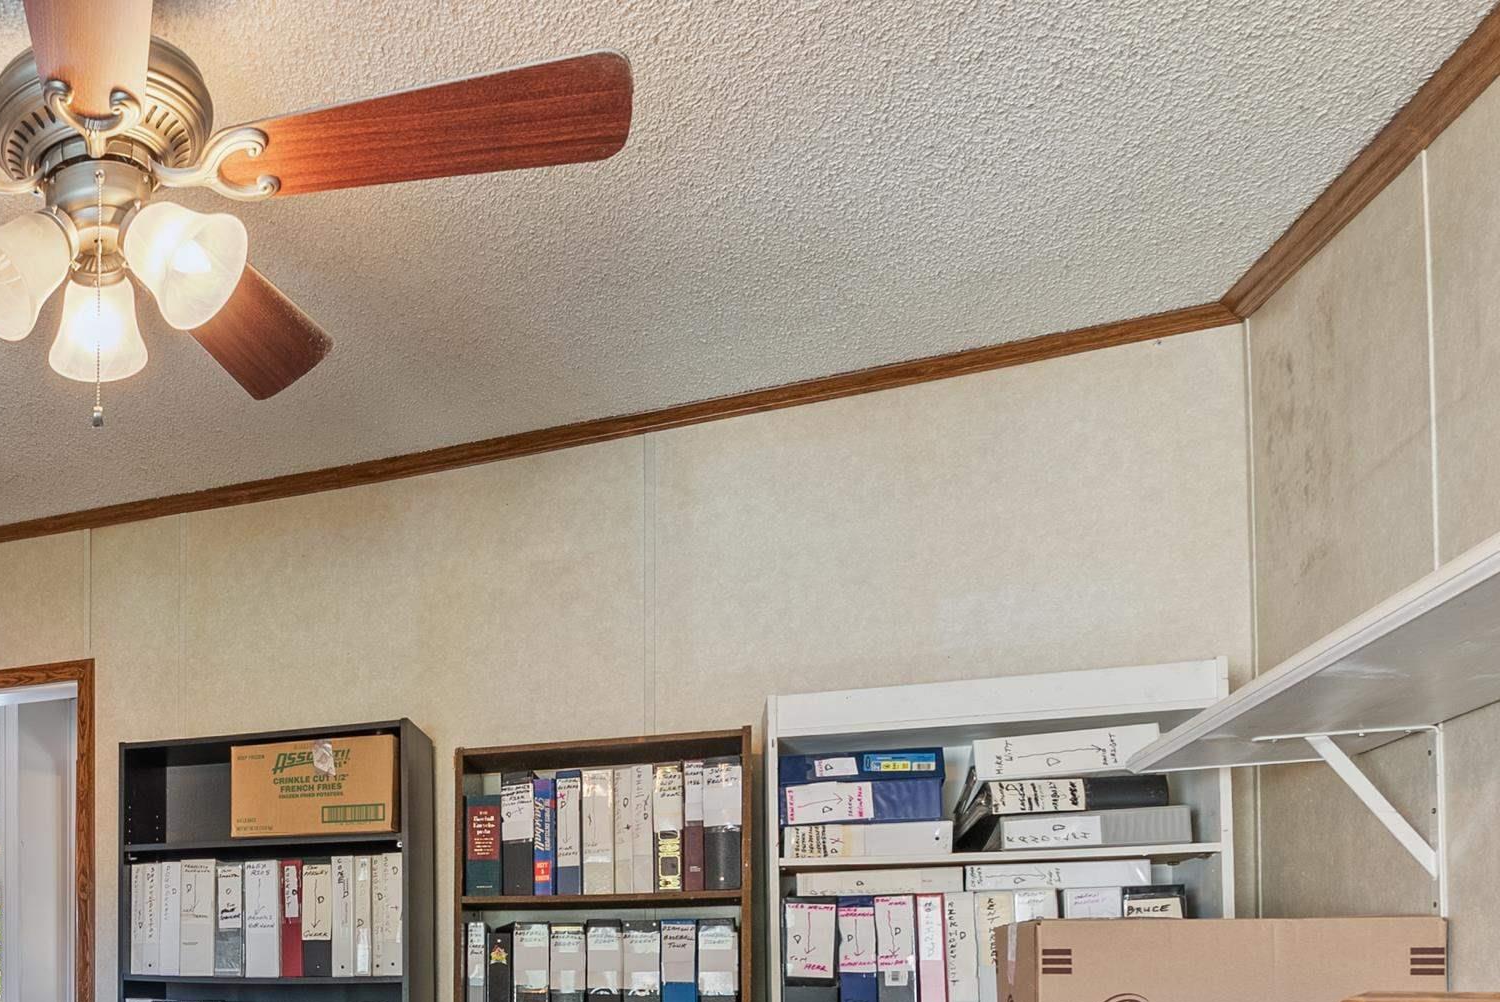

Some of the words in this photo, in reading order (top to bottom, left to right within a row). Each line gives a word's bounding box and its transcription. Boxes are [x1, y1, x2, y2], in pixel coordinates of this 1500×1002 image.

[273, 775, 311, 785] CRINKLE
[312, 774, 331, 783] CUT
[280, 785, 315, 793] FRENCH
[317, 783, 342, 791] FRIES
[534, 797, 545, 851] Baseball
[1126, 903, 1171, 916] BRUCE
